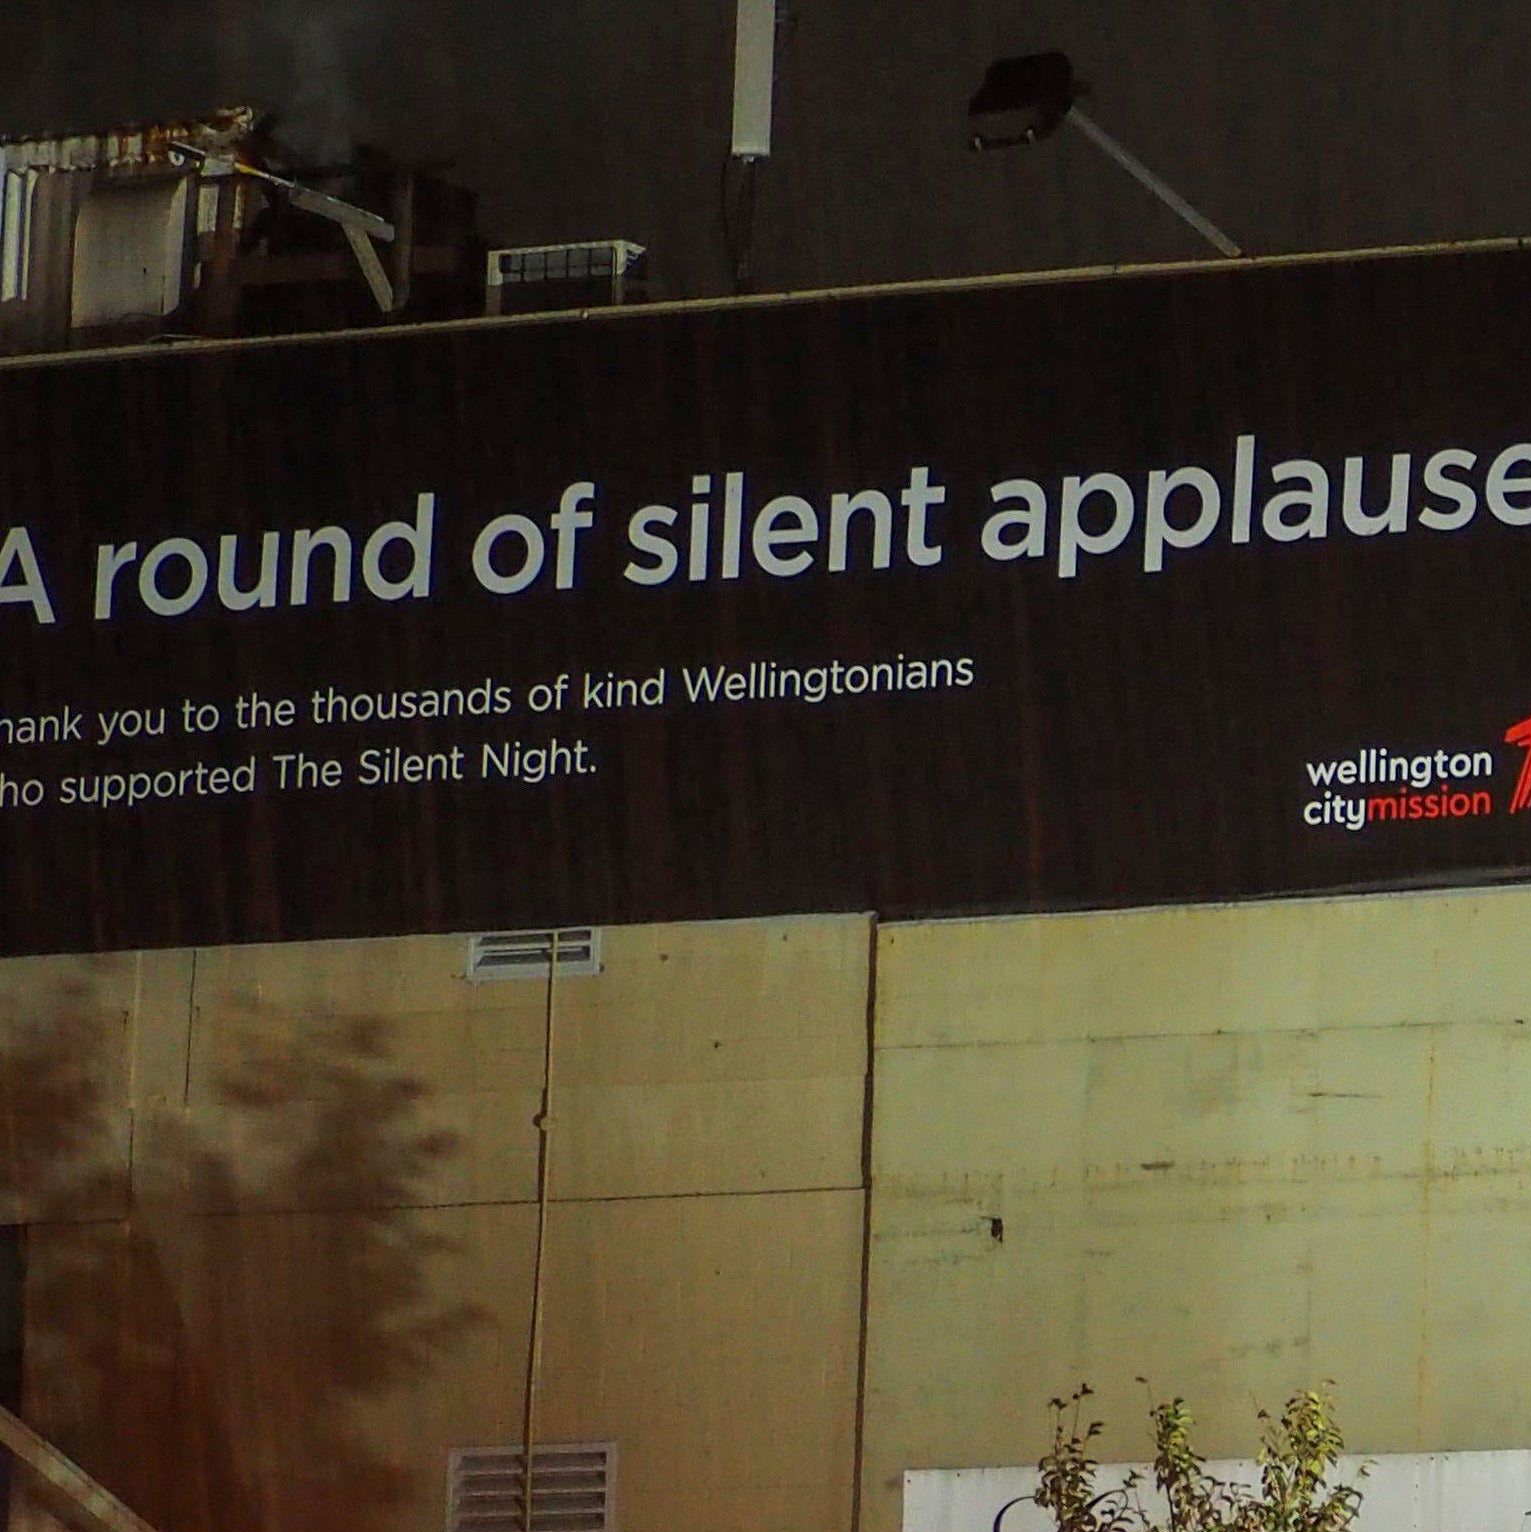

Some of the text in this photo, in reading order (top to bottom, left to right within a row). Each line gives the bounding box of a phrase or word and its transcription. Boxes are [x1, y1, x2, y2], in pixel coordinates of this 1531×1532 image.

[0, 527, 55, 624] A
[95, 492, 435, 620] round
[472, 481, 595, 594] of
[623, 466, 946, 585] silent
[98, 708, 165, 745] you
[182, 699, 220, 733] to
[235, 692, 296, 729] the
[312, 677, 512, 724] thousands
[528, 673, 569, 712] of
[584, 667, 665, 709] kind
[683, 653, 974, 703] Wellingtonians
[59, 755, 256, 808] supported
[273, 752, 342, 789] The
[358, 745, 465, 785] Silent
[481, 737, 597, 783] Night.
[1305, 749, 1493, 788] wellington
[1303, 788, 1492, 832] citymission
